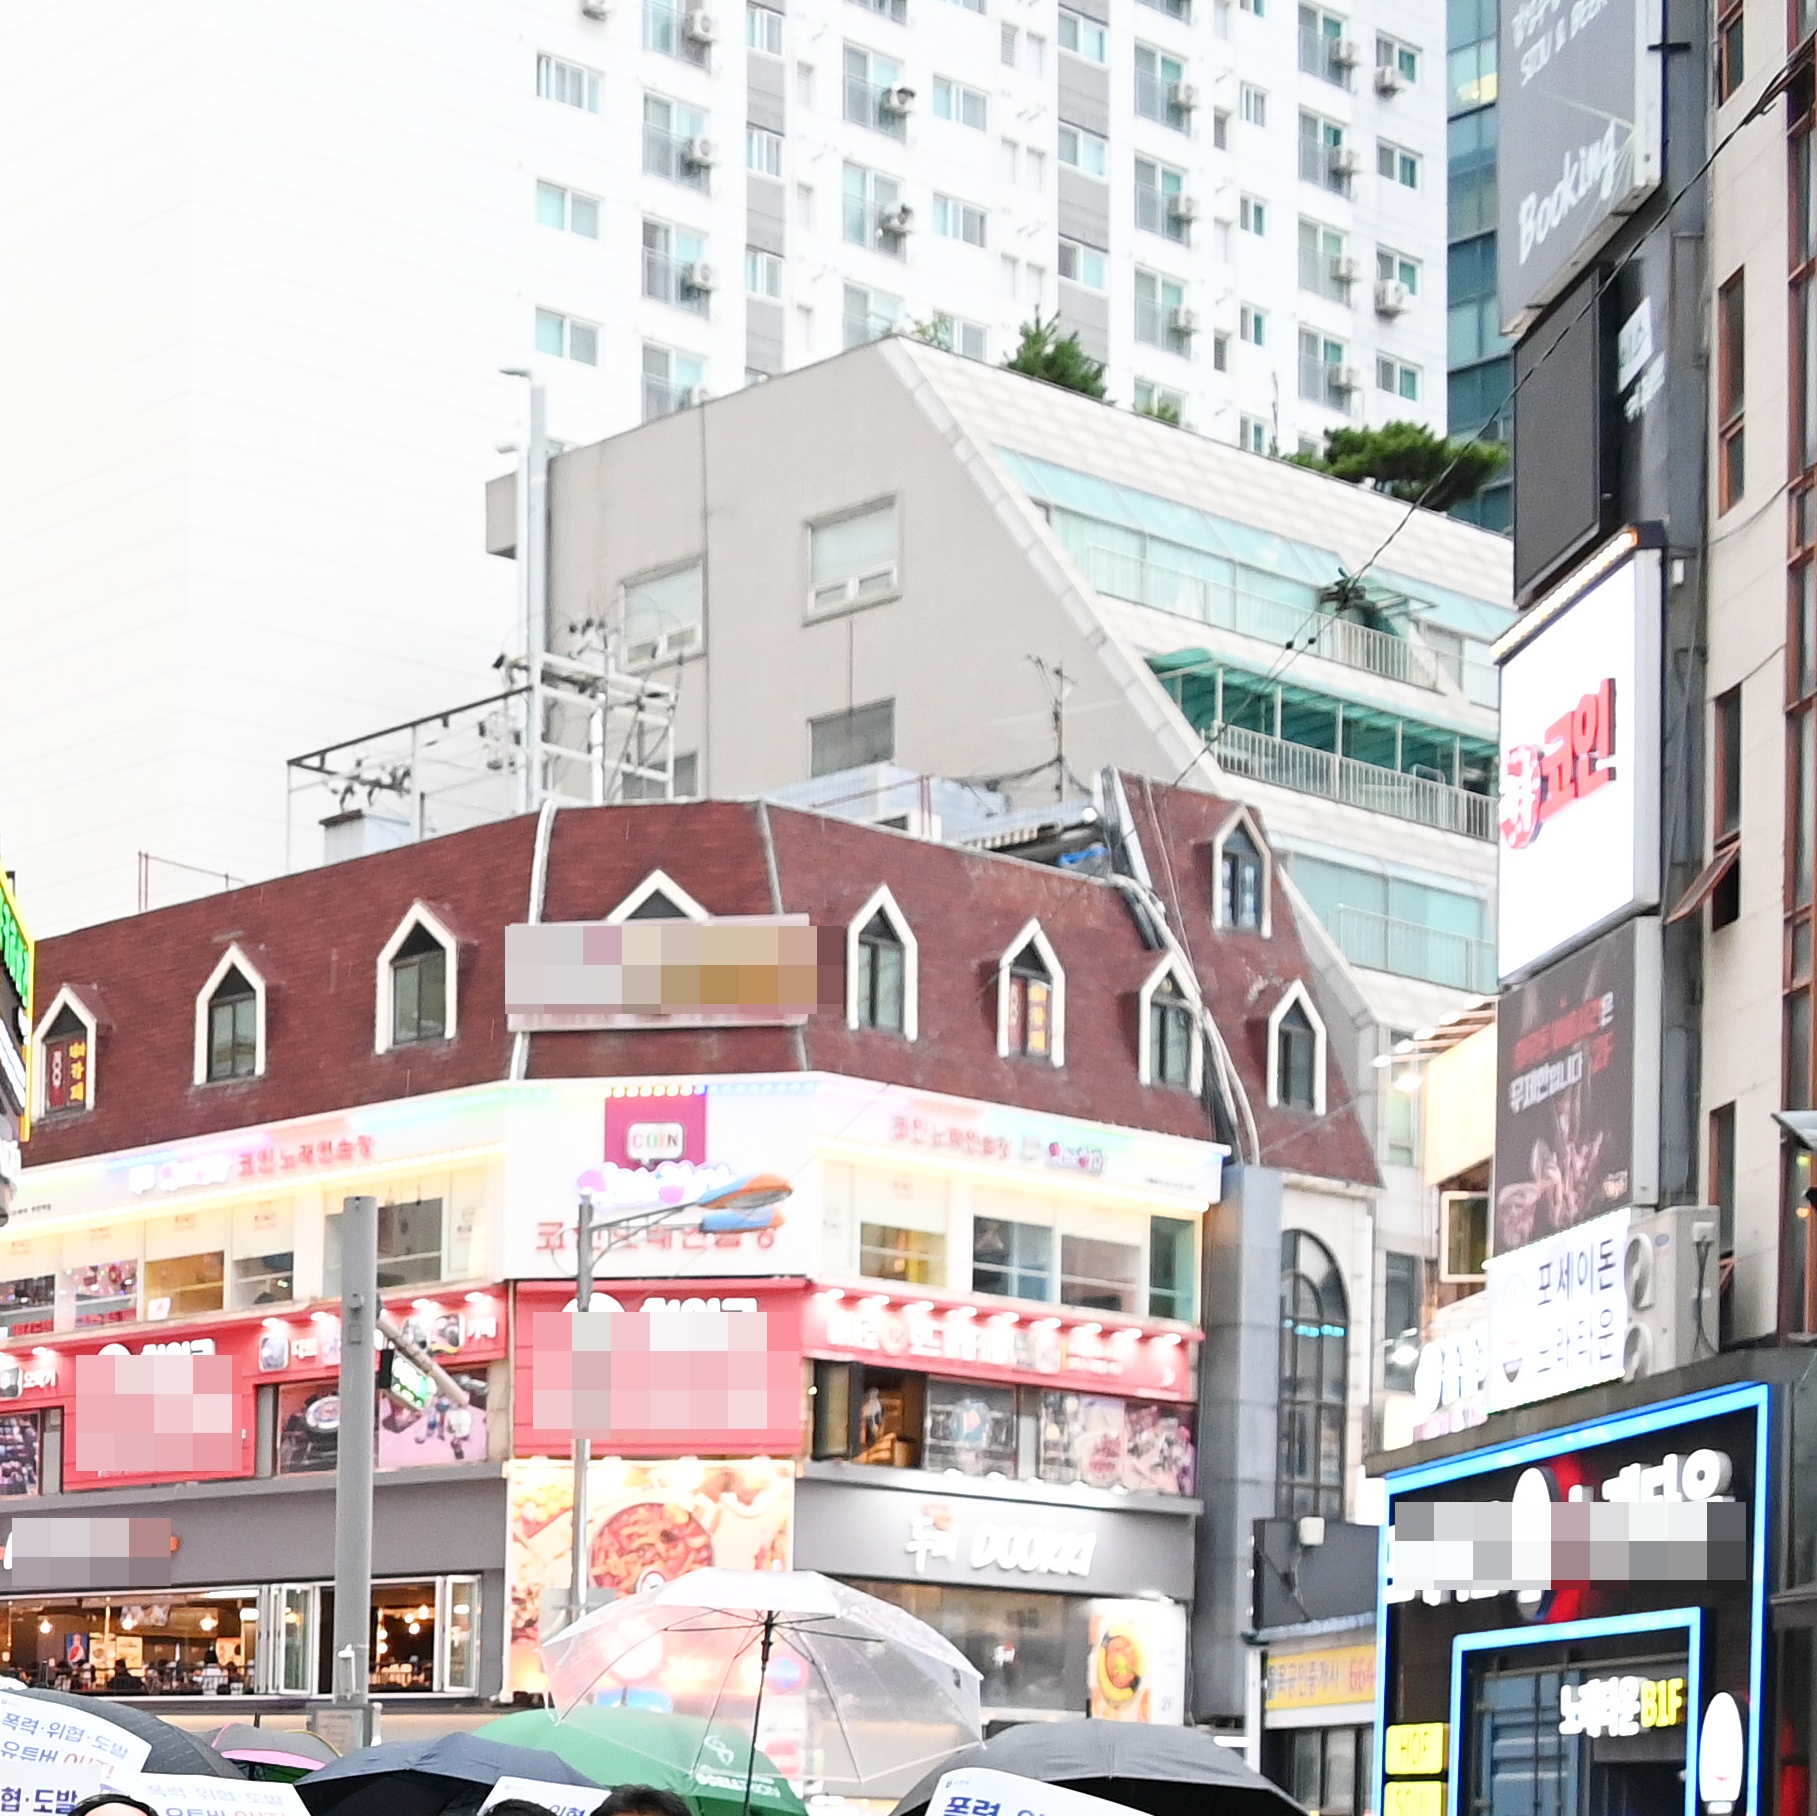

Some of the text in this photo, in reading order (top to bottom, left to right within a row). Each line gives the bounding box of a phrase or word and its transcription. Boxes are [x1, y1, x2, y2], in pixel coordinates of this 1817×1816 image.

[1519, 118, 1616, 267] Booking
[1541, 678, 1617, 814] 코인
[1640, 1677, 1687, 1729] B1F
